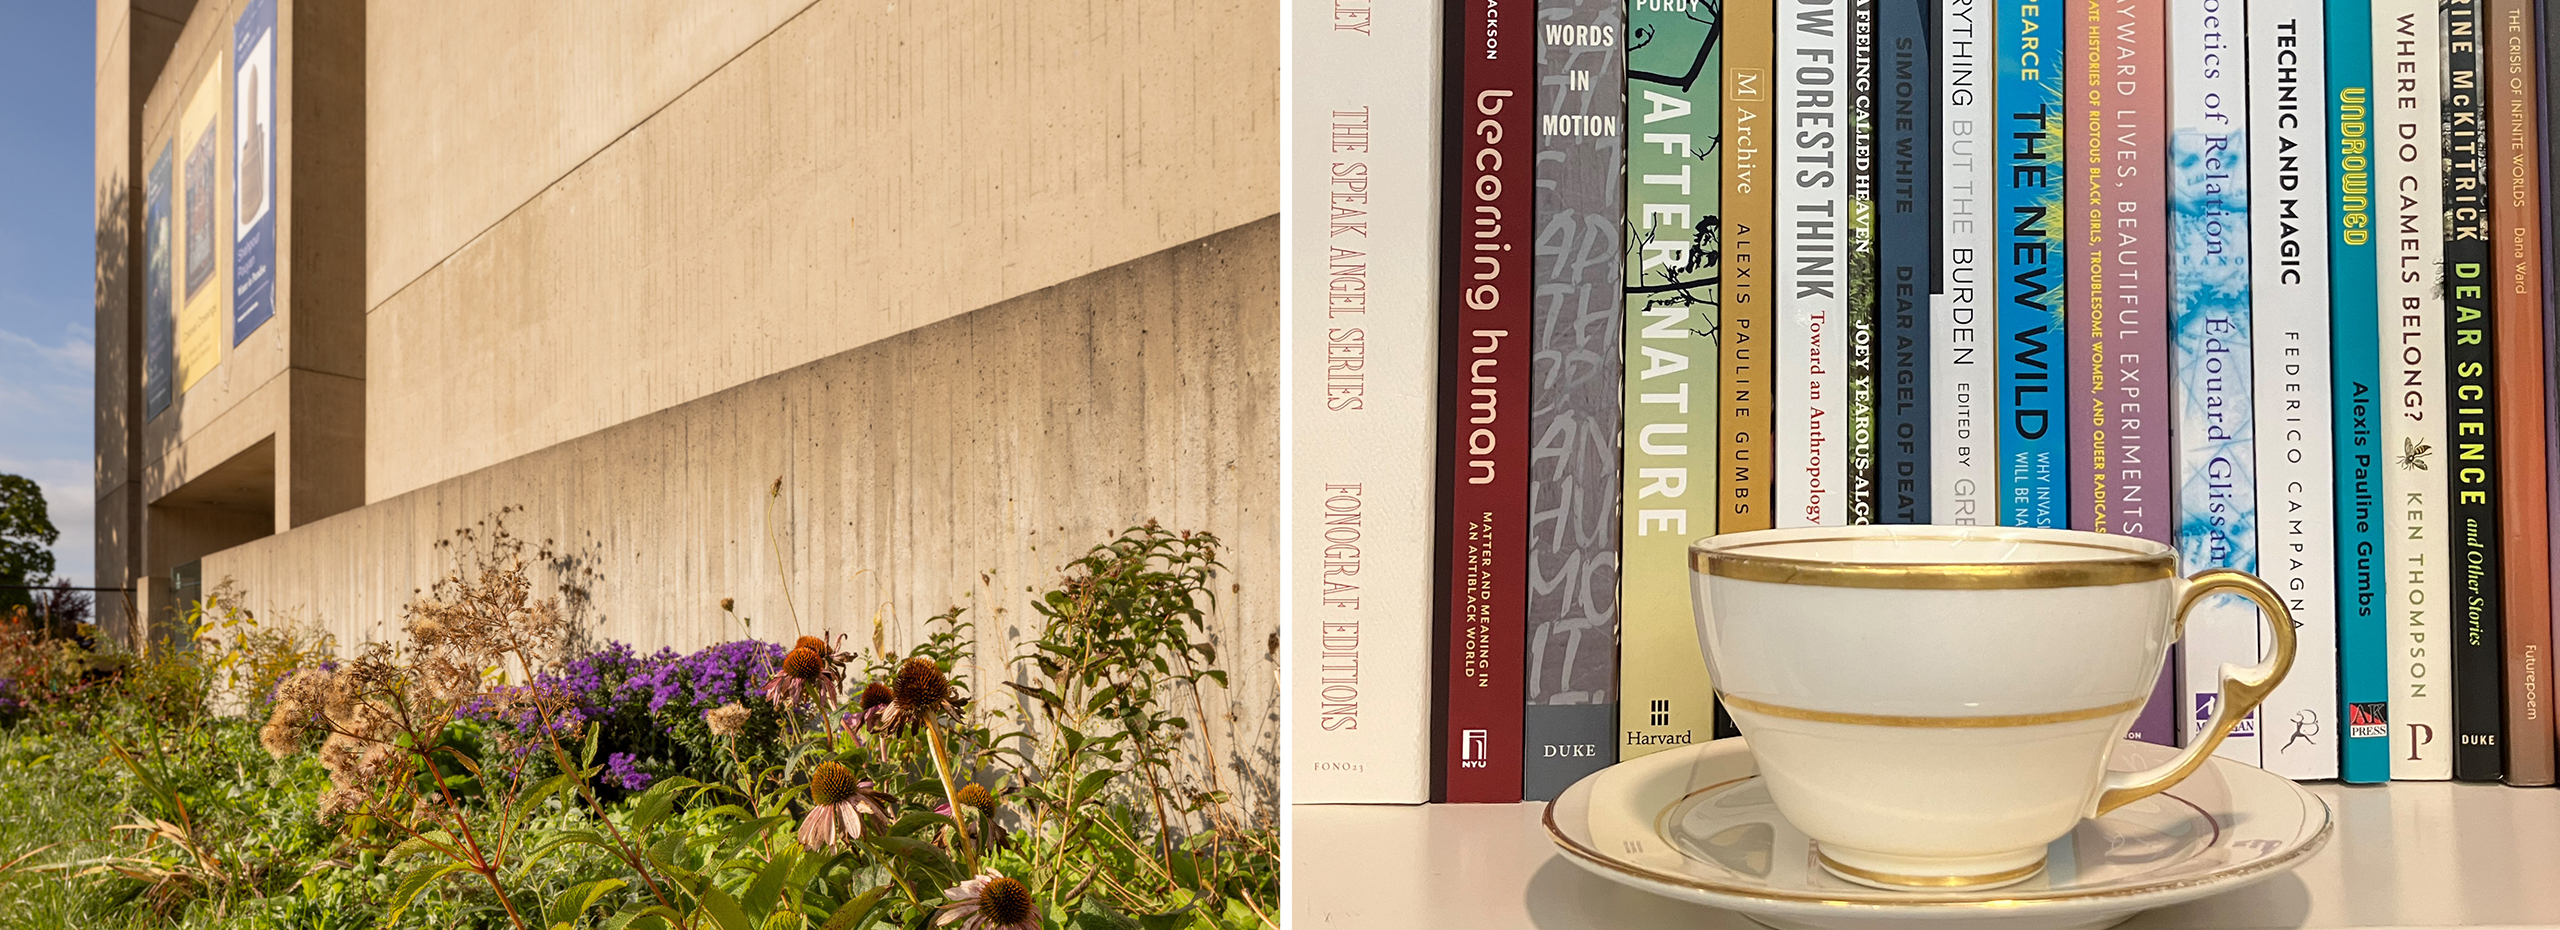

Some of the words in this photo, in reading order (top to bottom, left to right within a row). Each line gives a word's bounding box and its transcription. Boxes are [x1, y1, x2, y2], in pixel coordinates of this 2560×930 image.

[1545, 24, 1614, 47] WORDS
[1636, 0, 1698, 12] PURDY
[1796, 0, 1835, 37] W
[2451, 0, 2472, 53] INE
[2508, 8, 2520, 33] THE
[1856, 10, 1871, 94] FEELING
[2021, 0, 2039, 82] EARCE
[2088, 26, 2100, 86] HISTORIES
[2115, 0, 2136, 96] YWARD
[2396, 13, 2416, 109] WHERE
[2509, 37, 2521, 74] CRISIS
[1570, 70, 1589, 91] IN
[1738, 73, 1757, 95] M
[1895, 37, 1913, 131] SIMONE
[2088, 91, 2100, 107] OF
[2277, 19, 2298, 129] TECHNIC
[2510, 78, 2522, 95] OF
[1332, 106, 1369, 153] THE
[1542, 115, 1616, 137] MOTION
[1796, 49, 1835, 188] FORESTS
[1855, 95, 1870, 174] CALLED
[2089, 112, 2100, 164] RIOTOUS
[2204, 93, 2228, 125] of
[2511, 99, 2523, 150] INFINITE
[1737, 107, 1757, 194] Archive
[1952, 120, 1973, 172] BUT
[2013, 103, 2046, 189] THE
[2116, 110, 2137, 188] LIVES,
[2278, 136, 2299, 192] AND
[2339, 87, 2369, 245] UNDROWNED
[2398, 124, 2417, 163] DO
[2452, 70, 2478, 241] McKITTRICK
[1330, 163, 1368, 238] SPEAK
[1465, 90, 1513, 310] becoming
[1642, 90, 1692, 273] AFTER
[1895, 136, 1913, 214] WHITE
[2089, 168, 2101, 205] BLACK
[2205, 134, 2229, 255] Relation
[2513, 154, 2525, 208] WORLDS
[1855, 175, 1870, 253] HEAVEN
[1952, 180, 1973, 234] THE
[2089, 211, 2102, 246] GIRLS,
[2399, 176, 2419, 283] CAMELS
[1736, 224, 1751, 304] ALEXIS
[1796, 200, 1834, 300] THINK
[2013, 206, 2047, 311] NEW
[2118, 202, 2138, 340] BEAUTIFUL
[2279, 200, 2300, 285] MAGIC
[2514, 227, 2525, 258] Dana
[1328, 246, 1366, 319] ANGEL
[1896, 267, 1913, 328] DEAR
[1952, 248, 1974, 365] BURDEN
[2090, 251, 2103, 338] TROUBLESOME
[2455, 262, 2481, 343] DEAR
[2515, 262, 2527, 294] Ward
[1327, 328, 1365, 411] SERIES
[1735, 320, 1750, 417] PAULINE
[1810, 311, 1826, 375] Toward
[1855, 320, 1870, 371] JOEY
[2092, 340, 2104, 394] WOMEN,
[2402, 298, 2423, 422] BELONG?
[1811, 379, 1821, 400] an
[1896, 334, 1914, 415] ANGEL
[2014, 324, 2048, 440] WILD
[2205, 316, 2235, 442] Édouard
[2284, 331, 2302, 465] FEDERICO
[1468, 330, 1508, 484] human
[1638, 305, 1691, 536] NATURE
[1957, 383, 1969, 439] EDITED
[2093, 400, 2104, 425] AND
[2352, 382, 2369, 446] Alexis
[2457, 360, 2486, 505] SCIENCE
[1805, 407, 1827, 525] Anthropology
[1897, 422, 1914, 455] OF
[1958, 446, 1970, 467] BY
[2014, 452, 2029, 483] WILL
[2036, 452, 2050, 482] WHY
[2093, 430, 2105, 470] QUEER
[2120, 354, 2143, 534] EXPERIMENTS
[1735, 433, 1750, 514] GUMBS
[1897, 462, 1914, 523] DEAT
[2014, 488, 2029, 504] BE
[2094, 473, 2106, 533] RADICALS
[2353, 453, 2371, 533] Pauline
[1468, 522, 1478, 540] AN
[1481, 512, 1493, 567] MATTER
[2207, 456, 2233, 562] Glissan
[2406, 492, 2423, 540] KEN
[2466, 519, 2479, 546] and
[1322, 483, 1362, 610] FONOGRAF
[2287, 481, 2305, 629] CAMPAGNA
[2466, 548, 2486, 595] Other
[1465, 546, 1477, 622] ANTIBLACK
[1480, 571, 1491, 600] AND
[2356, 540, 2373, 617] Gumbs
[1465, 626, 1475, 677] WORLD
[1479, 605, 1491, 669] MEANING
[2407, 554, 2427, 698] THOMPSON
[2467, 596, 2486, 647] Stories
[1320, 620, 1360, 731] EDITIONS
[1478, 671, 1488, 688] IN
[2525, 644, 2538, 721] Futurepoem
[1627, 729, 1692, 745] Harvard
[2350, 703, 2386, 725] AK
[2352, 726, 2386, 736] PRESS
[2462, 735, 2495, 745] DUKE
[1313, 762, 1364, 773] FONO23
[1543, 744, 1597, 757] DUKE
